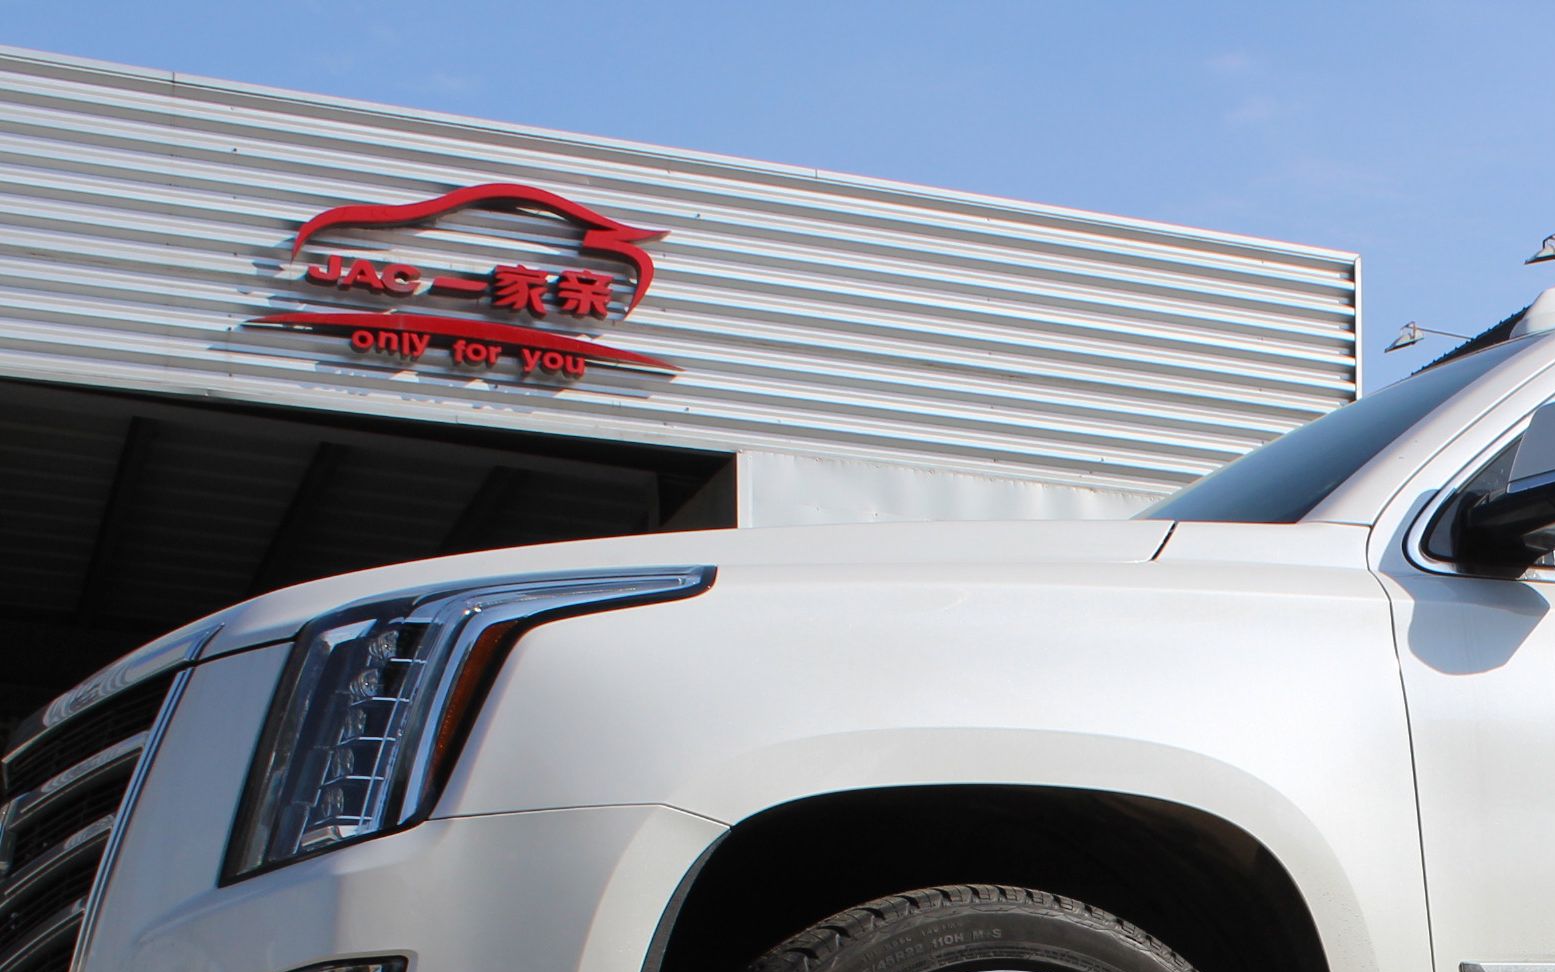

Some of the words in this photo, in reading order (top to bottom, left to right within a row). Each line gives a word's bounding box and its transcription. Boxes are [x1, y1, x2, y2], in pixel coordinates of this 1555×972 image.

[351, 329, 430, 358] only
[453, 339, 502, 364] for
[521, 348, 586, 377] you
